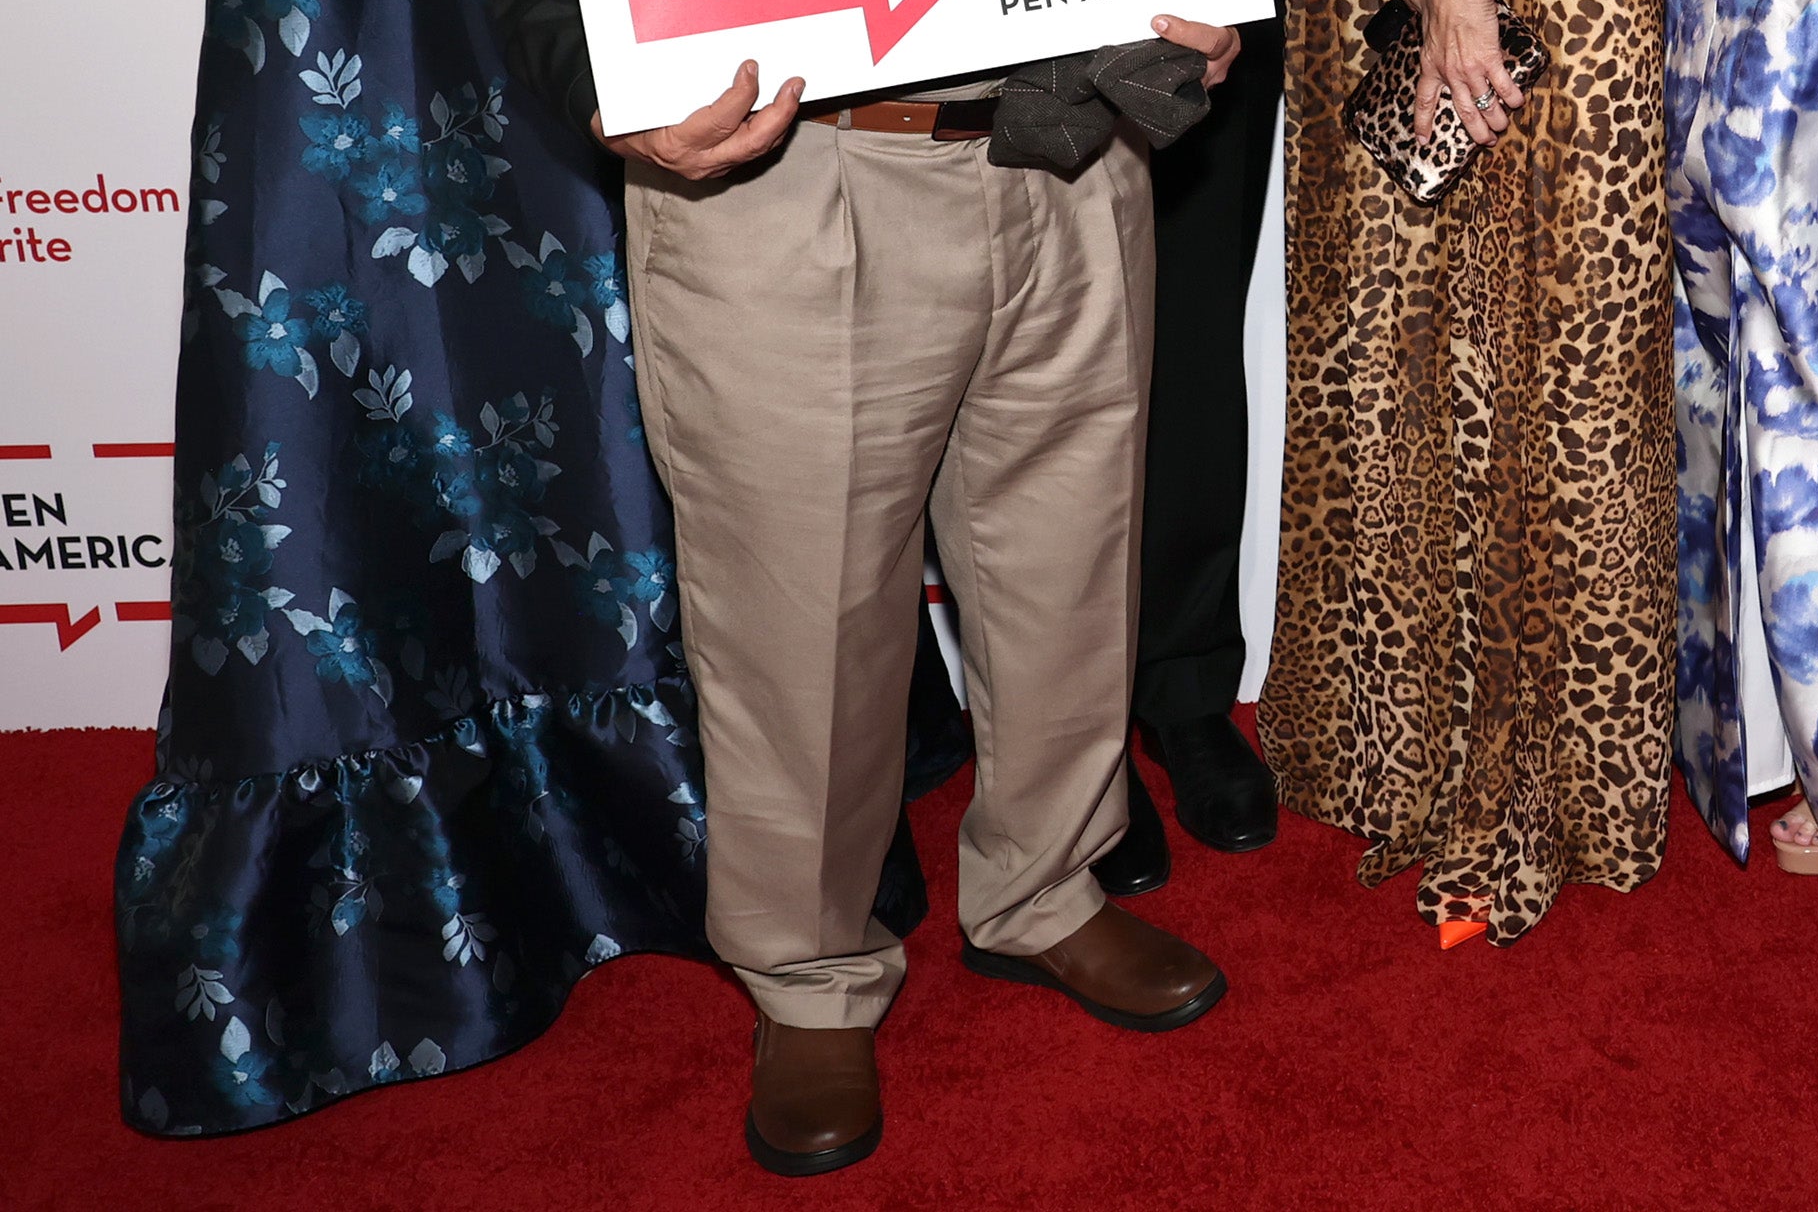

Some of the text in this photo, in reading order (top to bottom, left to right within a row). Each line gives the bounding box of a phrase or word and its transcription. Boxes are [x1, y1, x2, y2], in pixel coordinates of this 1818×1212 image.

[0, 173, 180, 214] reedom
[0, 227, 72, 263] rite
[1, 492, 67, 527] EN
[0, 535, 173, 570] MERIC
